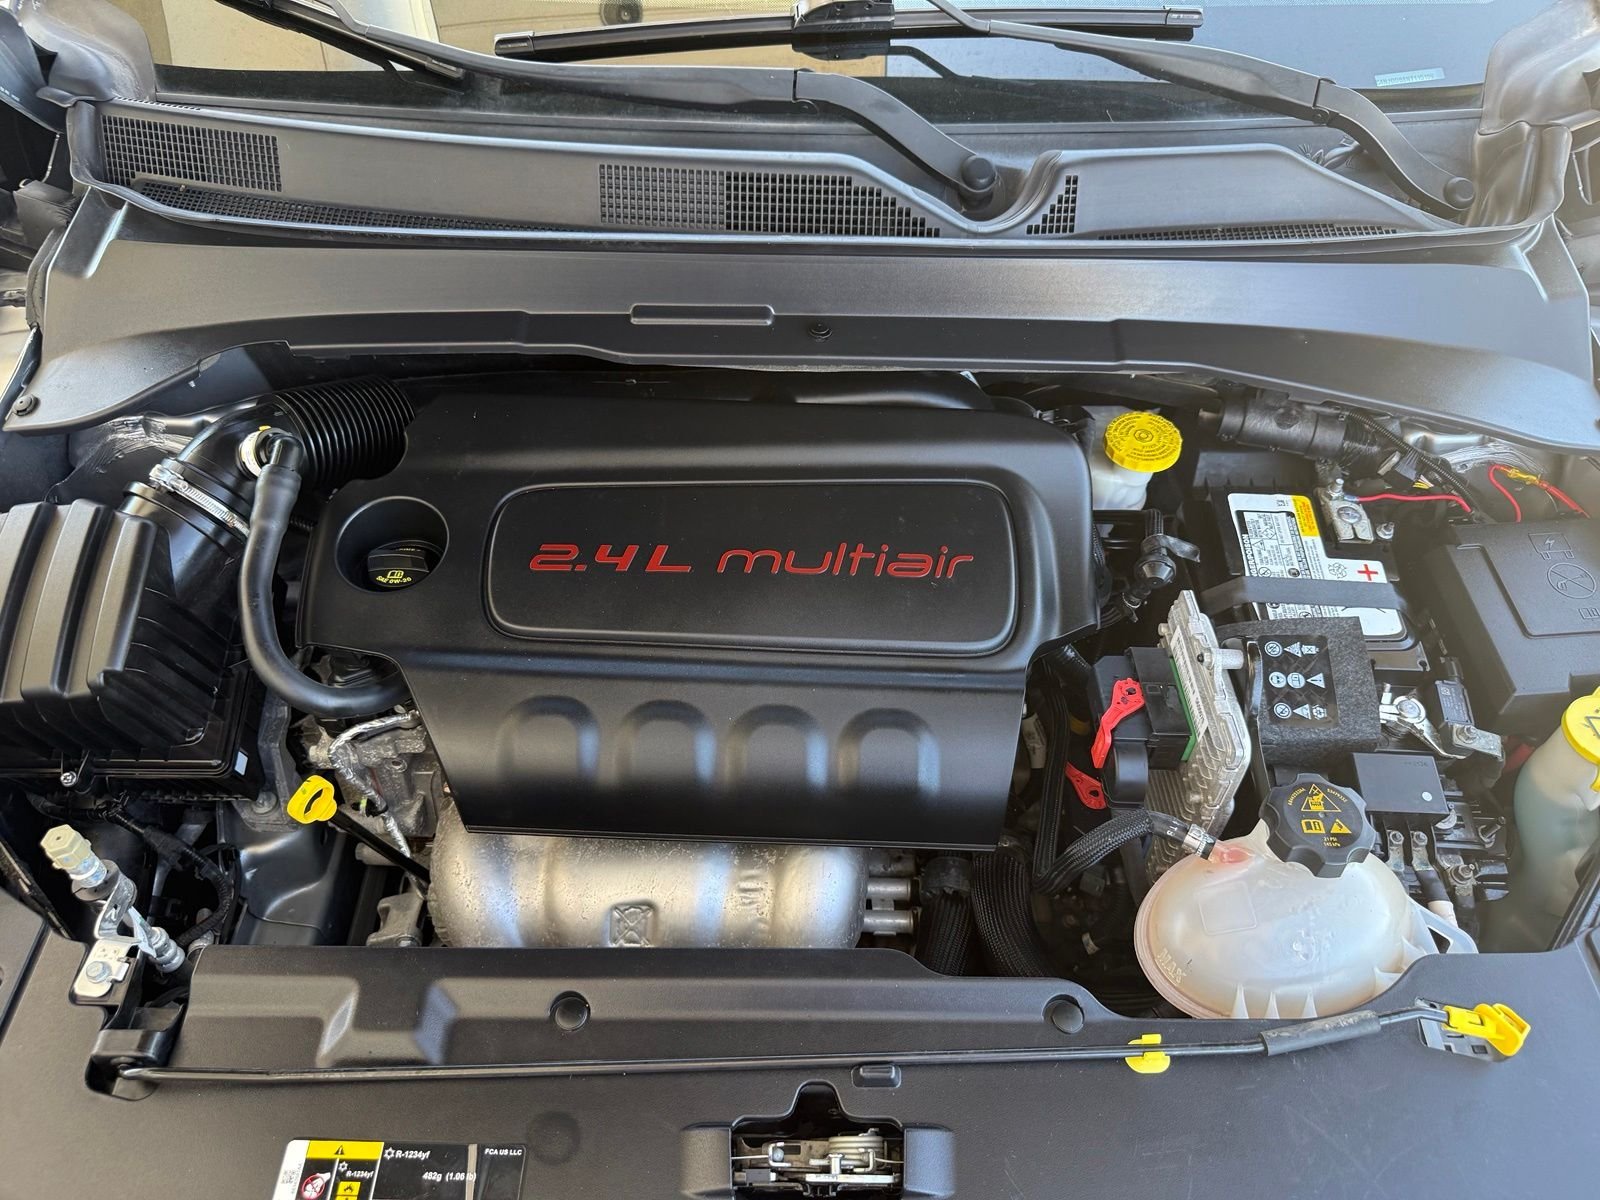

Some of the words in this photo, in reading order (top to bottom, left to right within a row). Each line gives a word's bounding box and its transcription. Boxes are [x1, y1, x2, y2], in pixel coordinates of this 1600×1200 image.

[716, 542, 974, 579] multiair
[395, 1150, 431, 1161] R-1234yf
[484, 1148, 499, 1156] FCA
[499, 1148, 509, 1156] US
